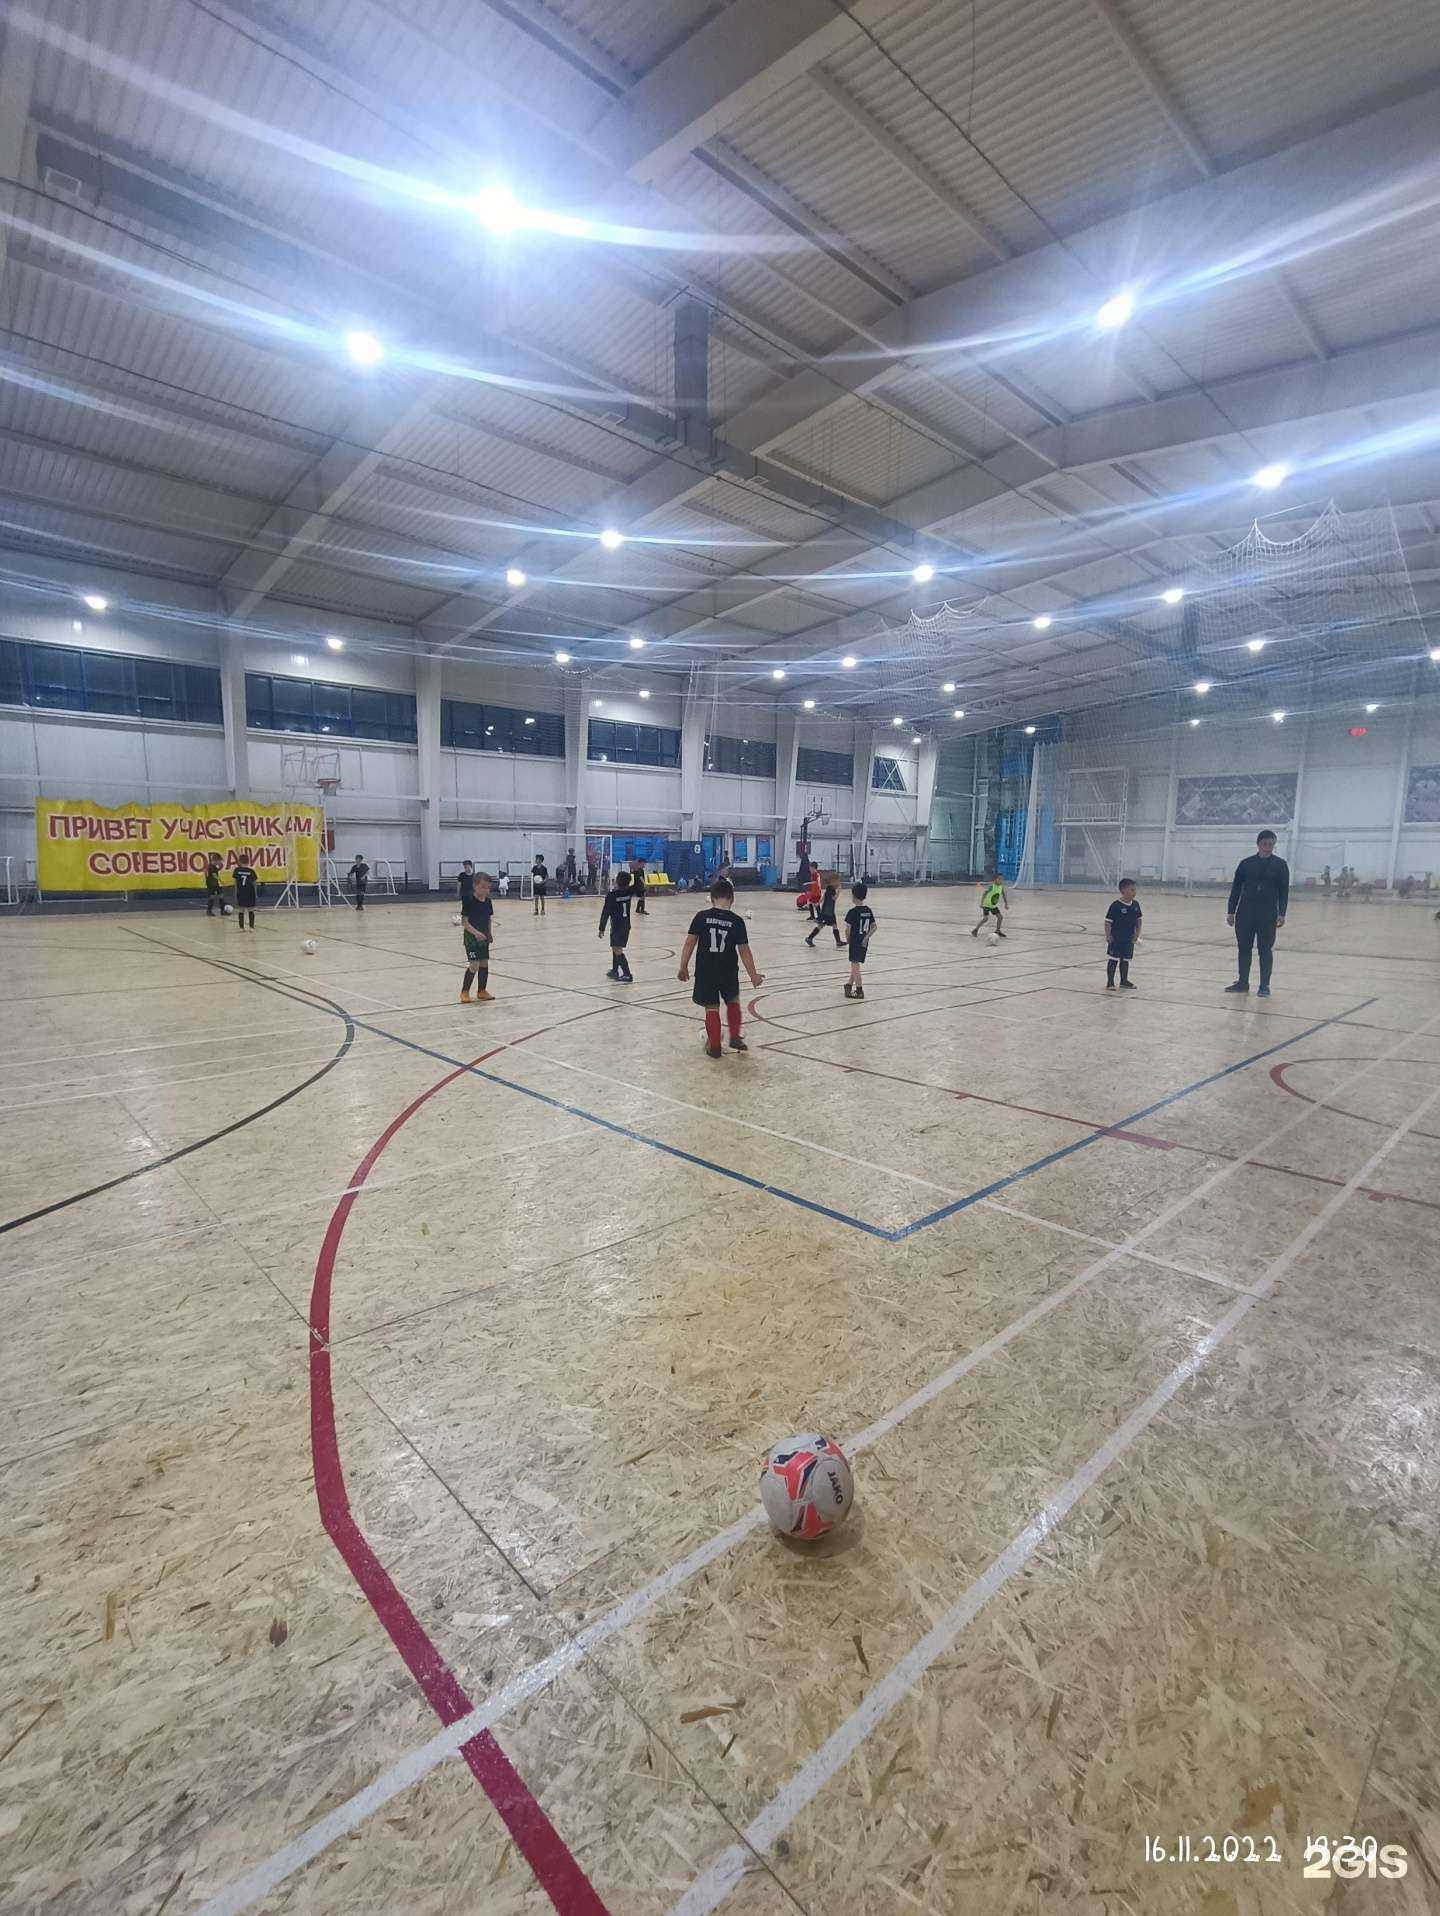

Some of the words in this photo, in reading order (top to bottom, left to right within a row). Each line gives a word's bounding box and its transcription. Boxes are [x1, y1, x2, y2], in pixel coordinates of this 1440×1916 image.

[49, 815, 151, 840] ПРИВЕТ
[241, 875, 247, 886] 7
[709, 927, 728, 952] 17
[827, 1471, 844, 1505] JAKO
